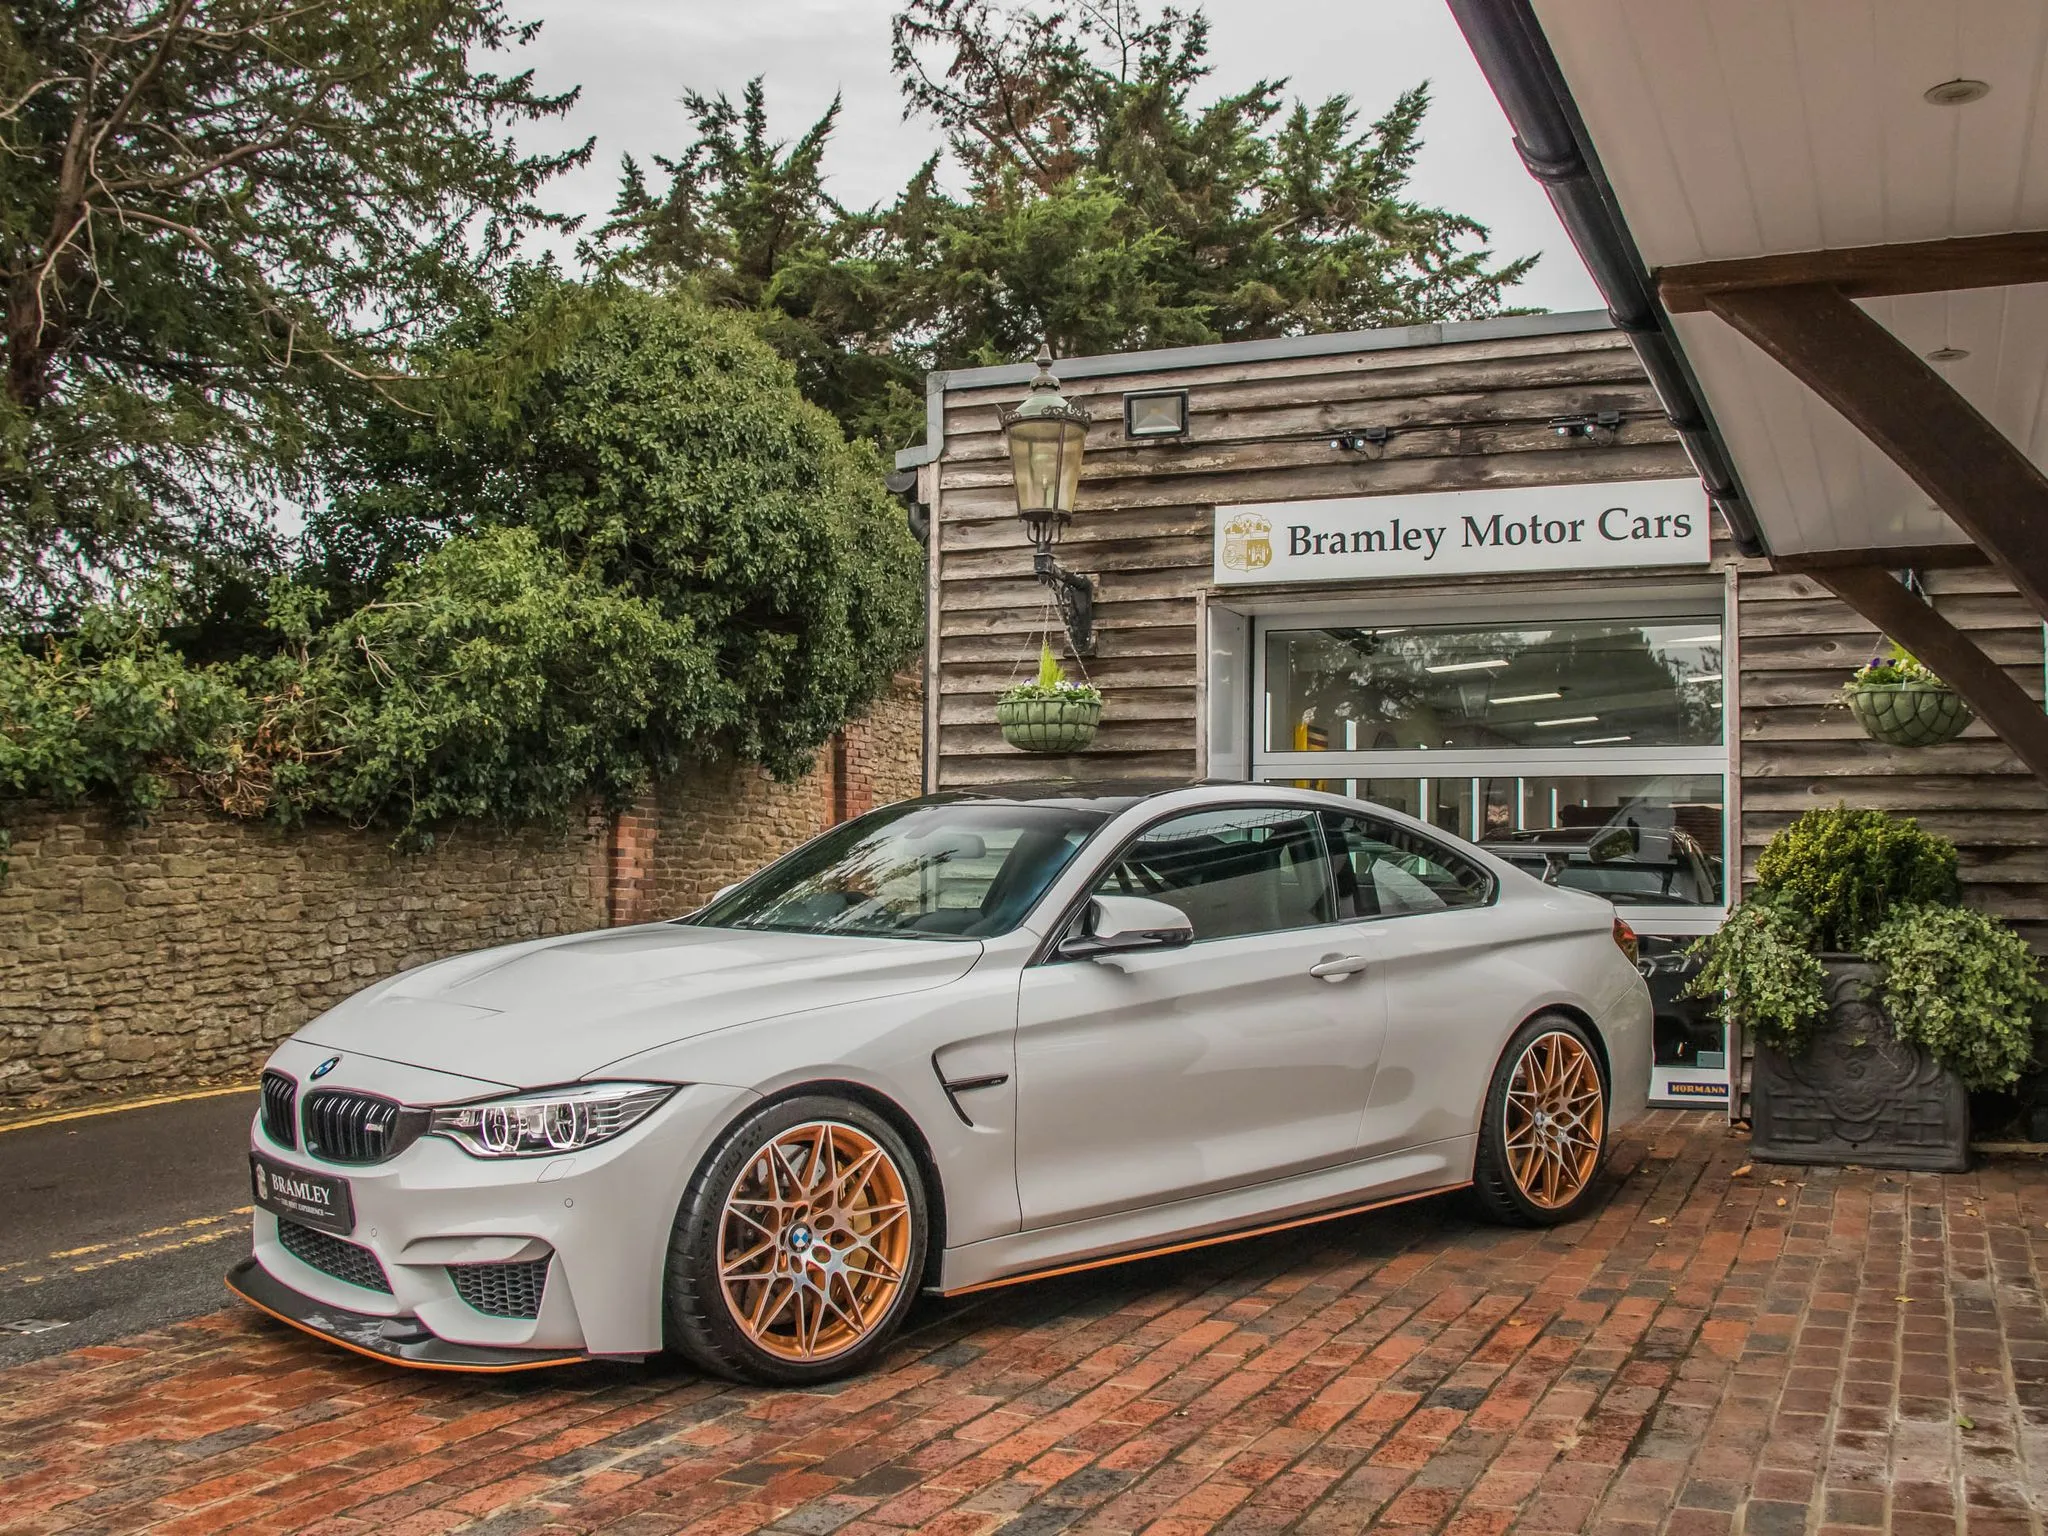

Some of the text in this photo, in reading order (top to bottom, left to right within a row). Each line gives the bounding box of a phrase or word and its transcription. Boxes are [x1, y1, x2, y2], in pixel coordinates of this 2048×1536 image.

[1288, 506, 1693, 560] Bramley Motor Cars
[271, 1173, 330, 1205] BRAMLEY
